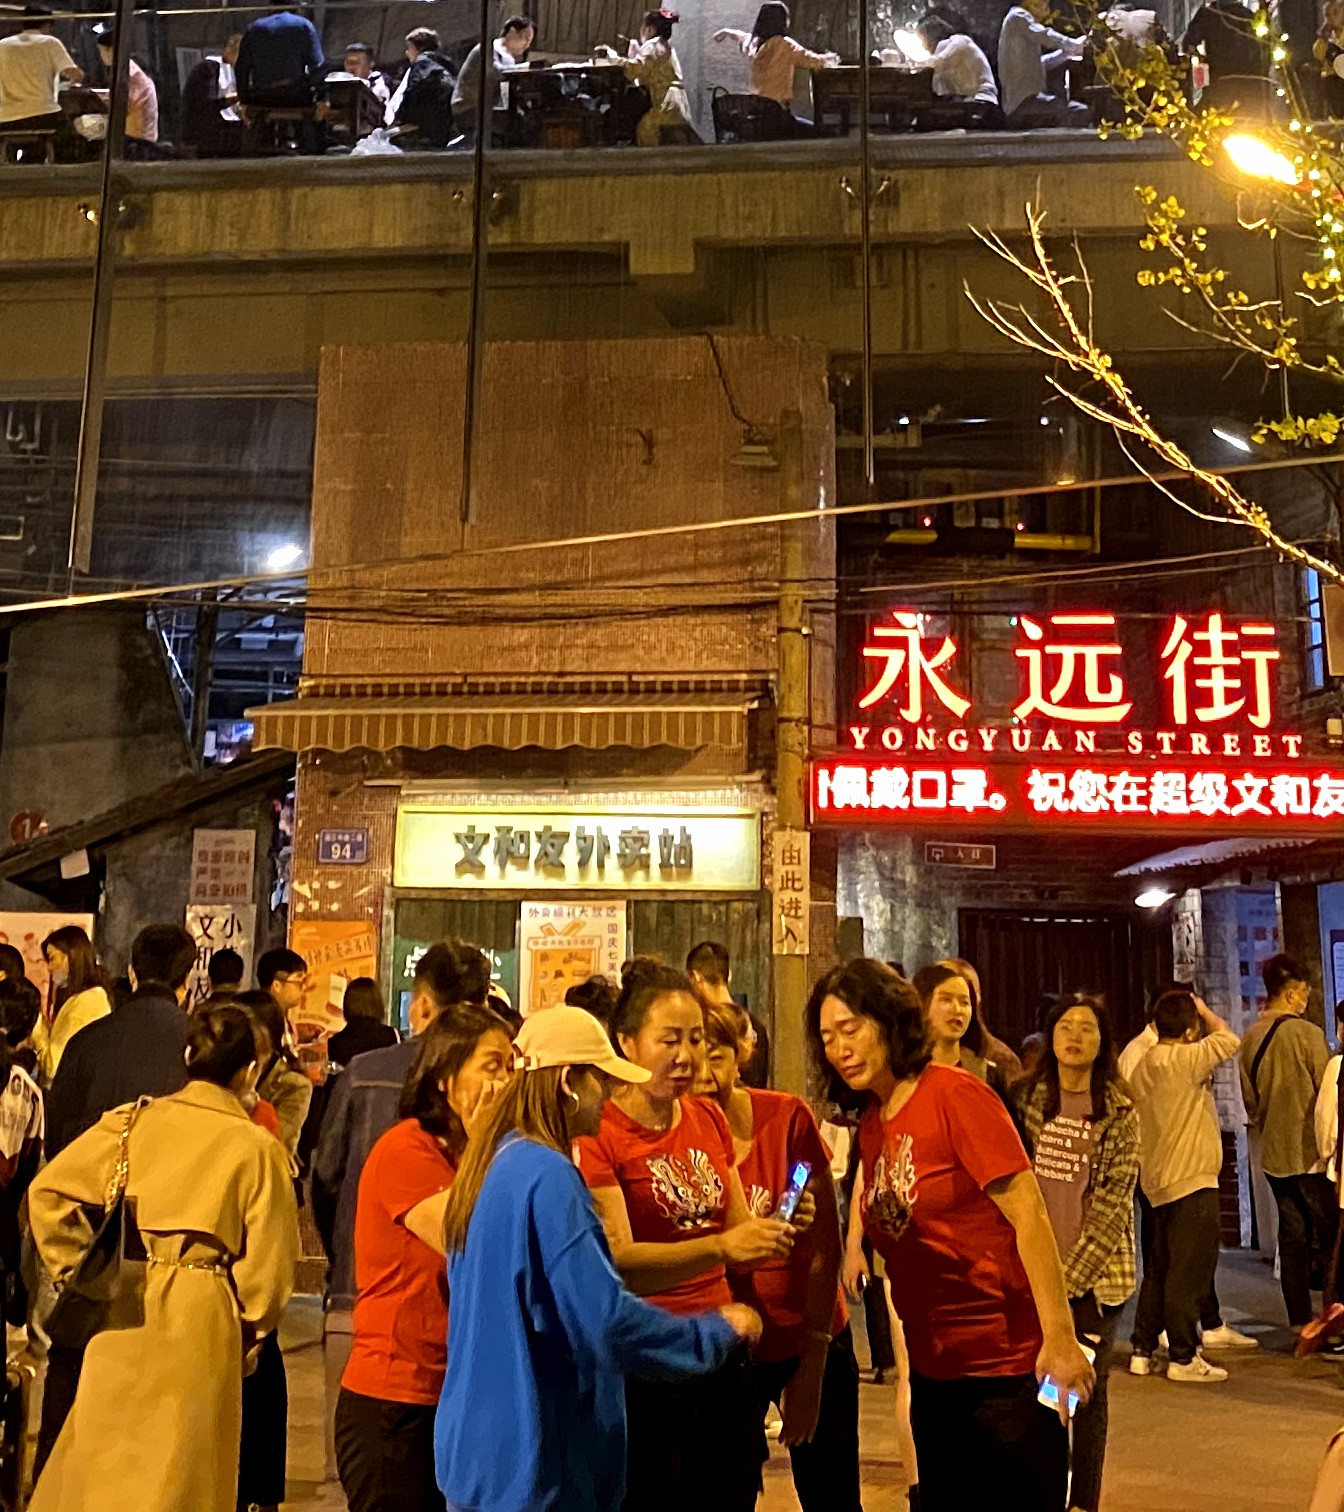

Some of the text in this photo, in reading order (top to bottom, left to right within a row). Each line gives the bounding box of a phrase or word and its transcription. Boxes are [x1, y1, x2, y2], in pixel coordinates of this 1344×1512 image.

[856, 610, 1282, 729] 永远街
[848, 724, 1305, 758] YONGYUAN STREET
[331, 842, 351, 859] 94
[453, 823, 696, 875] 文和友外卖站
[775, 842, 805, 945] 由此进入
